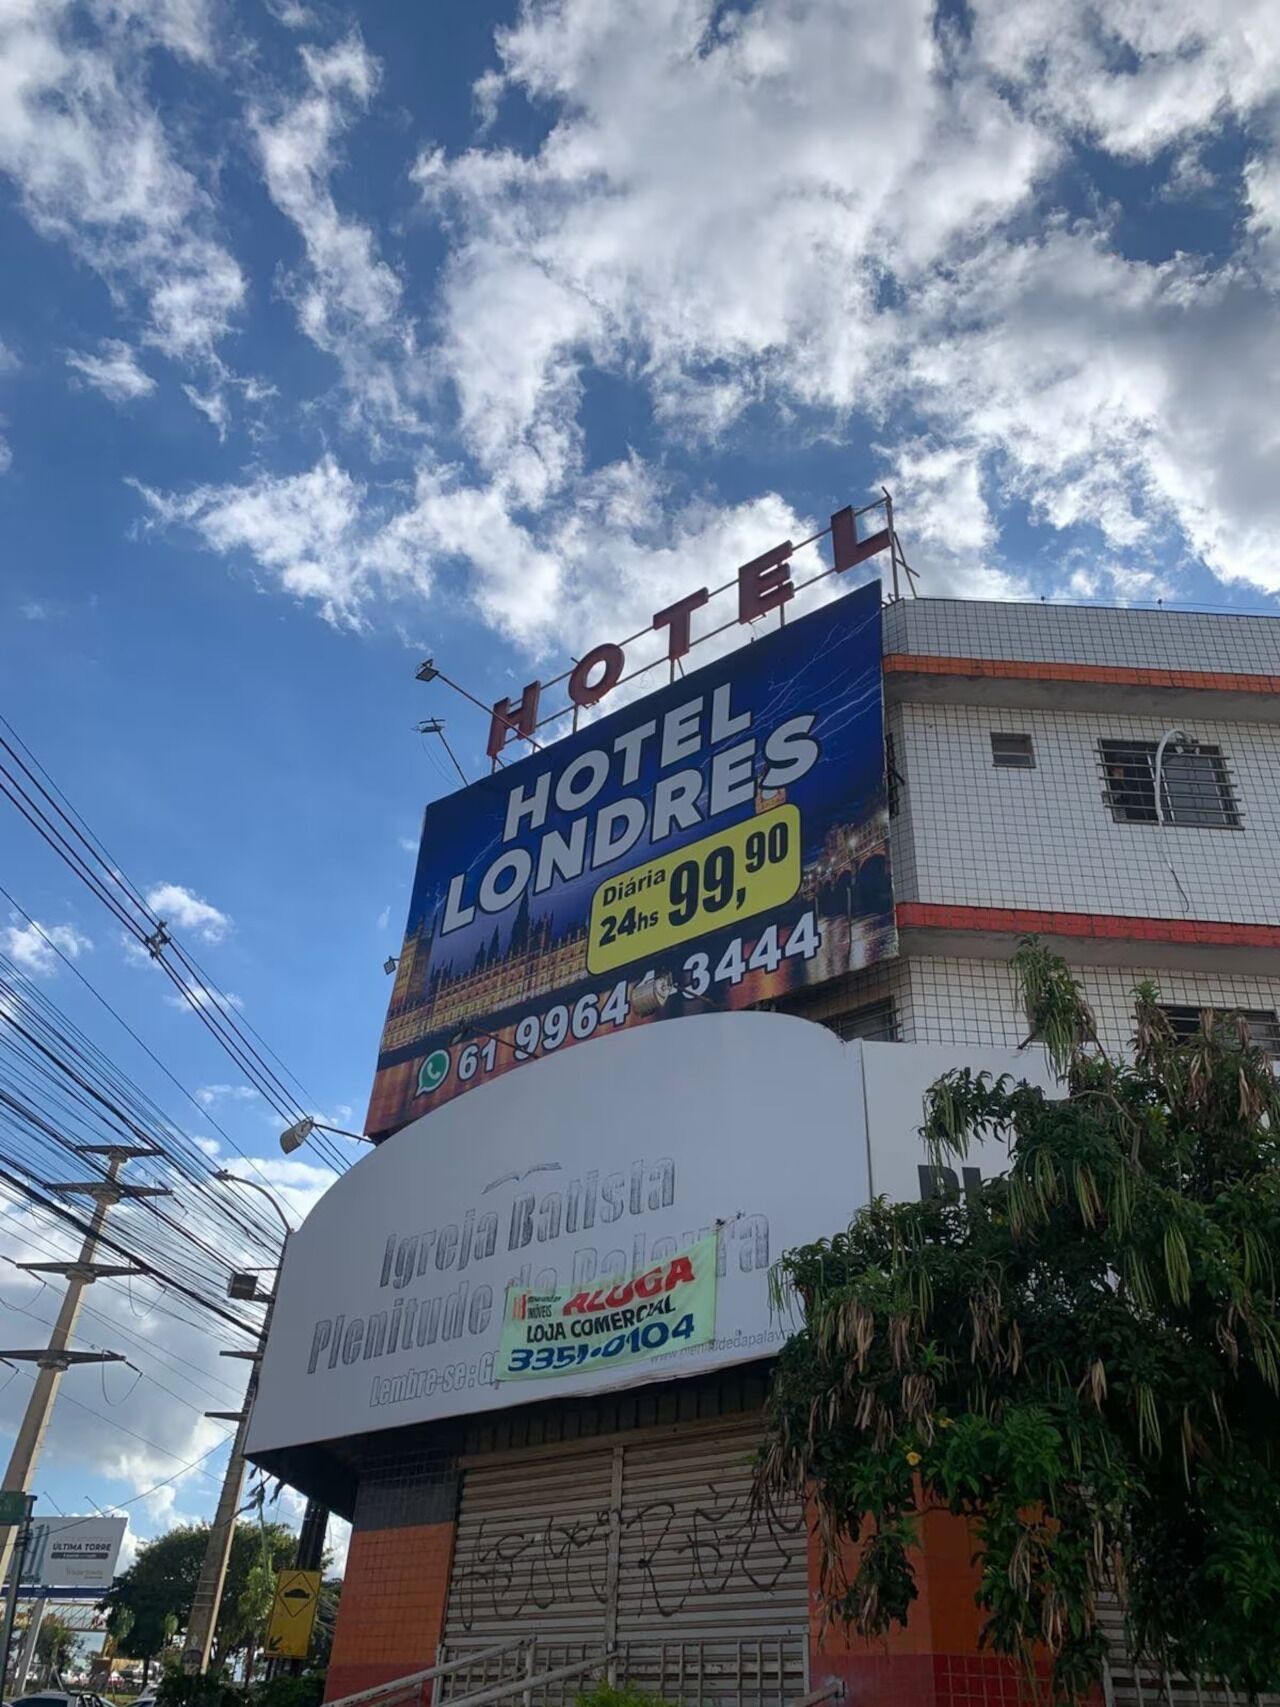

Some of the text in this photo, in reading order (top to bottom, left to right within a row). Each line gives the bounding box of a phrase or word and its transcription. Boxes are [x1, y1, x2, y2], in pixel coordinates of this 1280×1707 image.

[486, 504, 892, 758] HOTEL
[503, 682, 751, 842] HOTEL
[441, 714, 819, 936] LONDRES
[603, 868, 666, 907] Diária
[599, 905, 659, 948] 24hs
[457, 1038, 498, 1081] 61
[379, 1156, 676, 1289] Igreja Batista
[527, 1294, 677, 1344] LOJA COMERCIAL
[562, 1256, 696, 1317] ALUGA
[307, 1280, 493, 1374] Plenitude
